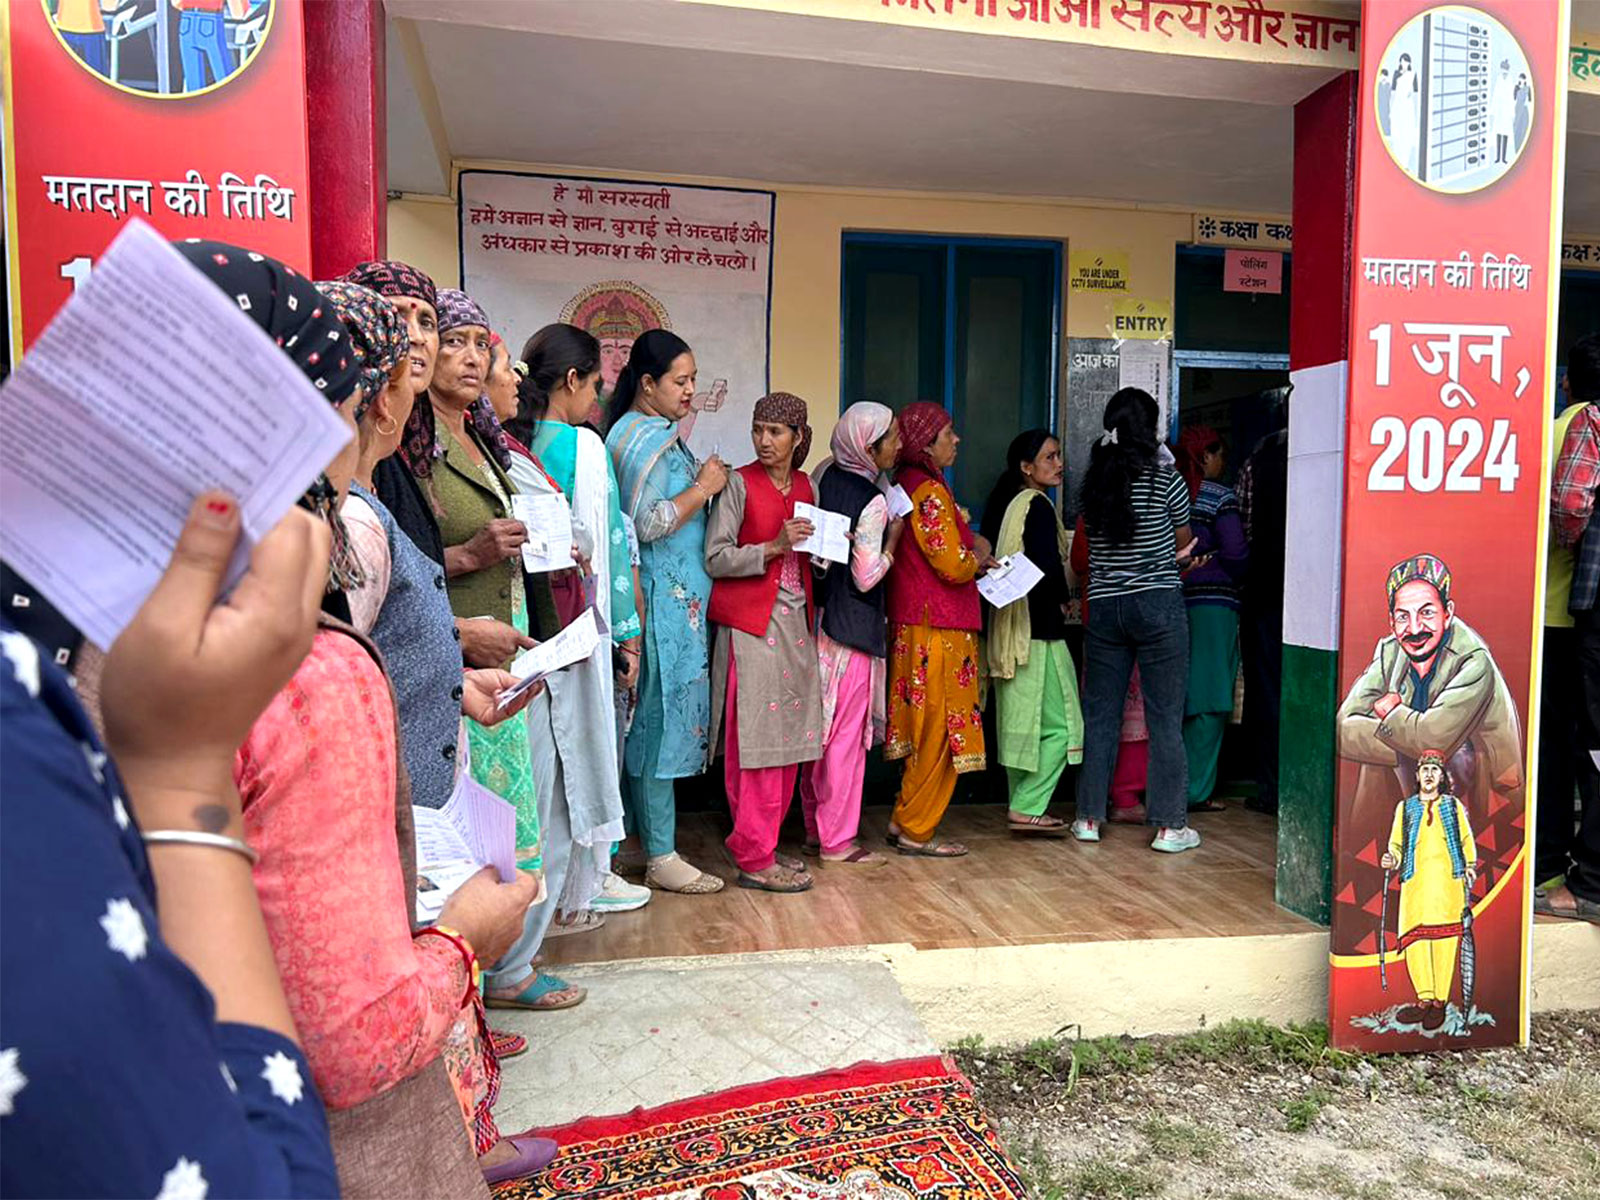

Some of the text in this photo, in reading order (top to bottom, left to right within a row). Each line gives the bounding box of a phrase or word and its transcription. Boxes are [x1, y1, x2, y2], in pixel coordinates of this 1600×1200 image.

[1110, 0, 1211, 39] सत्य
[1215, 0, 1288, 48] और
[1291, 12, 1361, 52] ज्ञान
[41, 169, 295, 220] मतदान की तिथि
[553, 182, 569, 202] हे
[598, 188, 671, 210] सरस्वती
[498, 210, 544, 226] अज्ञान
[547, 208, 567, 228] से
[611, 215, 659, 240] बुराई
[664, 217, 682, 238] से
[740, 221, 769, 245] और
[1220, 220, 1260, 241] कक्षा
[550, 235, 570, 255] से
[572, 241, 630, 260] प्रकाश
[633, 241, 657, 261] की
[660, 245, 695, 264] ओर
[696, 248, 713, 266] ले
[1240, 257, 1269, 271] पोलिंग
[1072, 278, 1126, 290] CCTV SURVEILLANCE
[1079, 268, 1120, 279] YOU ARE UNDER
[1238, 275, 1267, 288] स्टेशन
[1362, 251, 1532, 291] मतदान की तिथि
[1115, 315, 1168, 332] ENTRY
[1073, 353, 1101, 369] आज
[1369, 323, 1392, 387] 1
[1367, 416, 1521, 492] 2024
